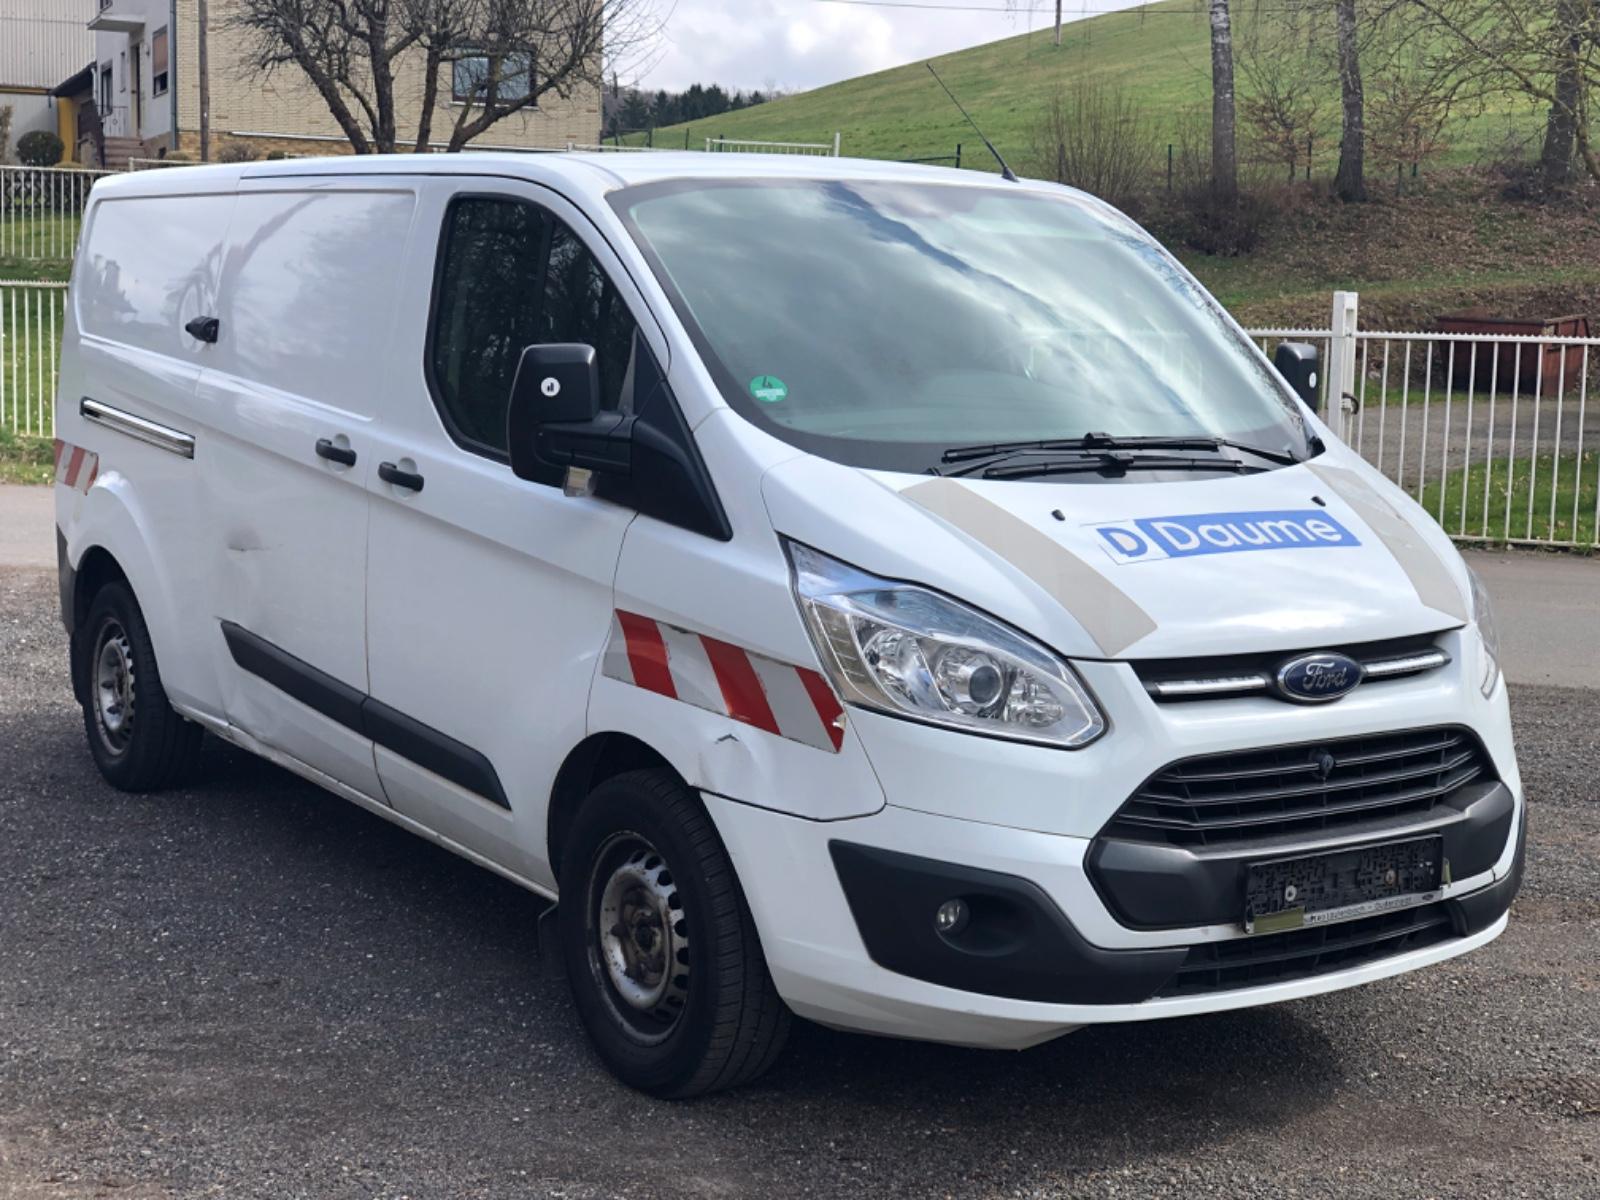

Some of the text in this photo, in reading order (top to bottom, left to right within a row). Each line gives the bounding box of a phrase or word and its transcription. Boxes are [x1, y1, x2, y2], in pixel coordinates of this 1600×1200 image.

[1096, 519, 1342, 557] D Daume
[1302, 662, 1348, 690] Ford
